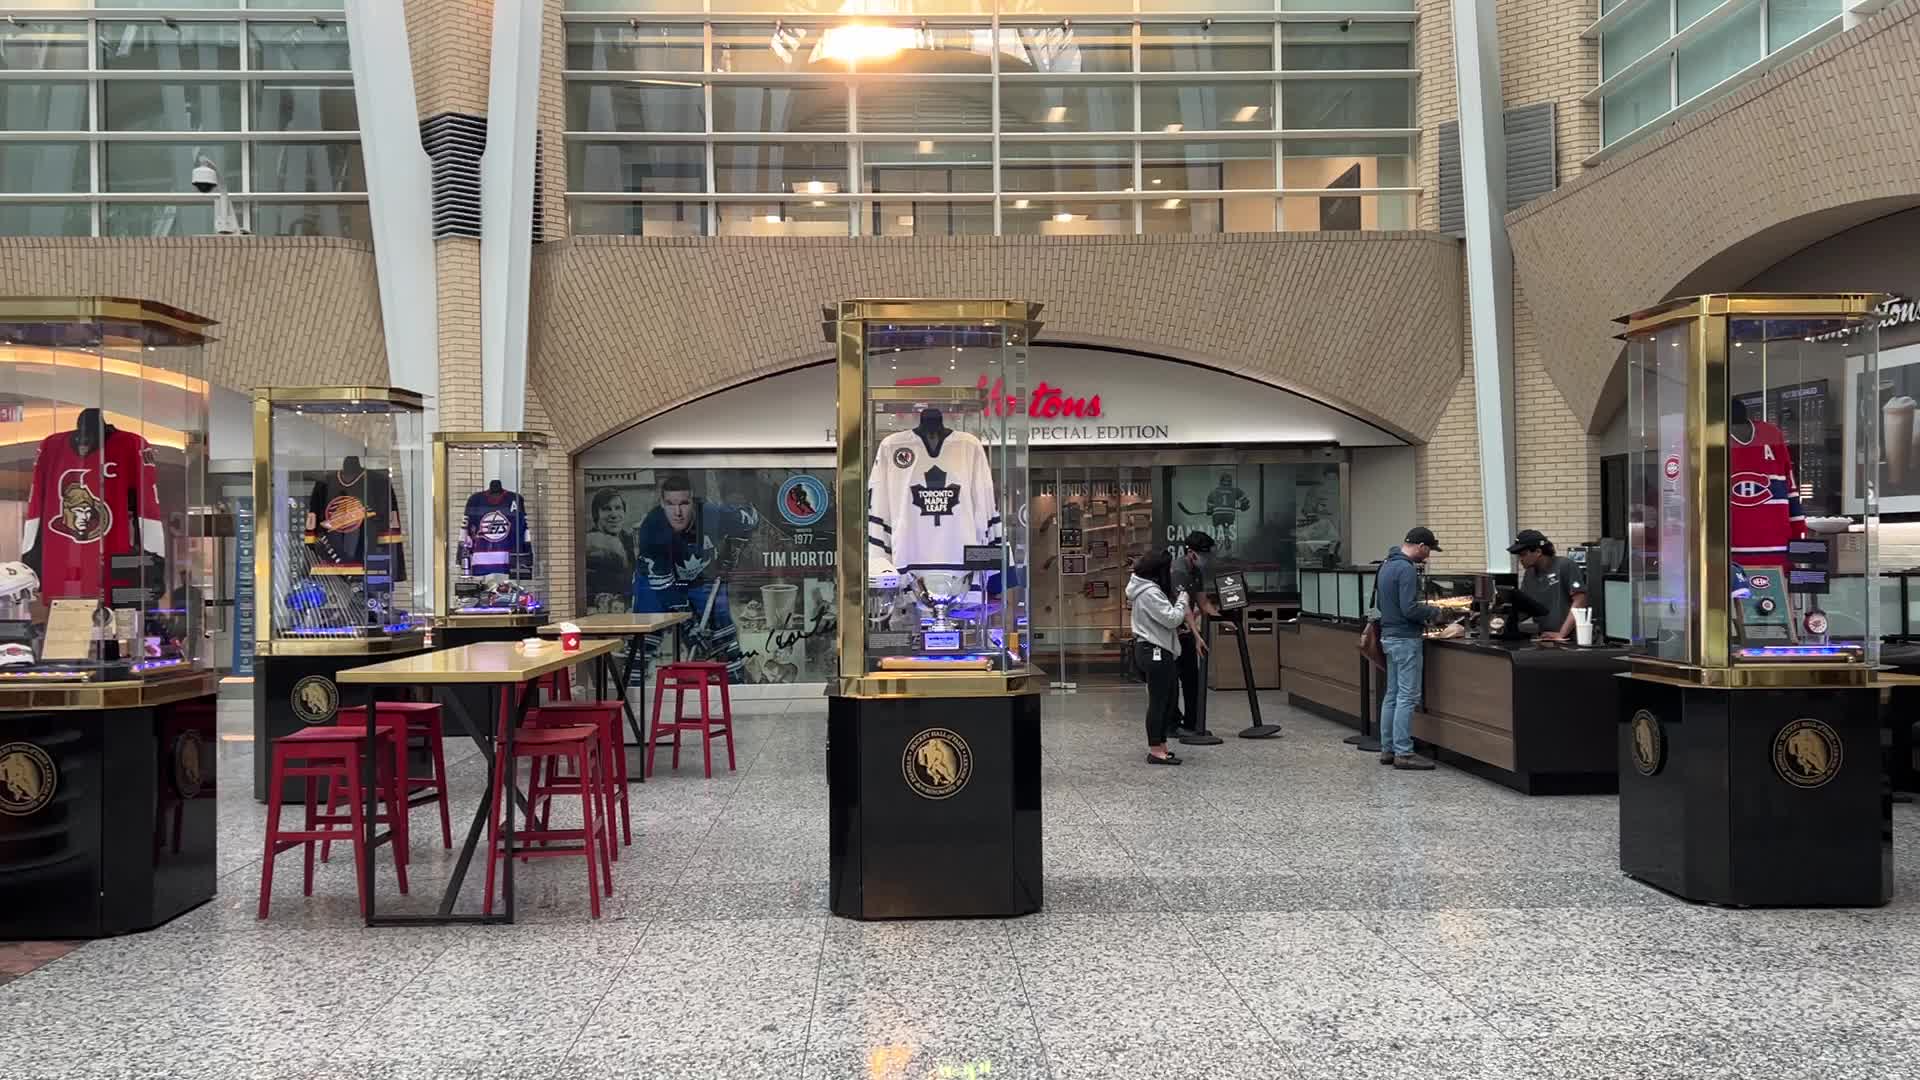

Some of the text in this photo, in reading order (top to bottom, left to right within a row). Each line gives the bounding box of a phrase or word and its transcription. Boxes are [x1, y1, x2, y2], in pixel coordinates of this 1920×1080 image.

[1096, 425, 1169, 439] EDITION
[103, 461, 118, 478] C
[918, 490, 954, 498] TORONTO
[924, 496, 949, 505] MAPLE
[926, 503, 948, 512] LEAFS
[793, 533, 814, 545] 1977
[762, 551, 786, 567] TIM
